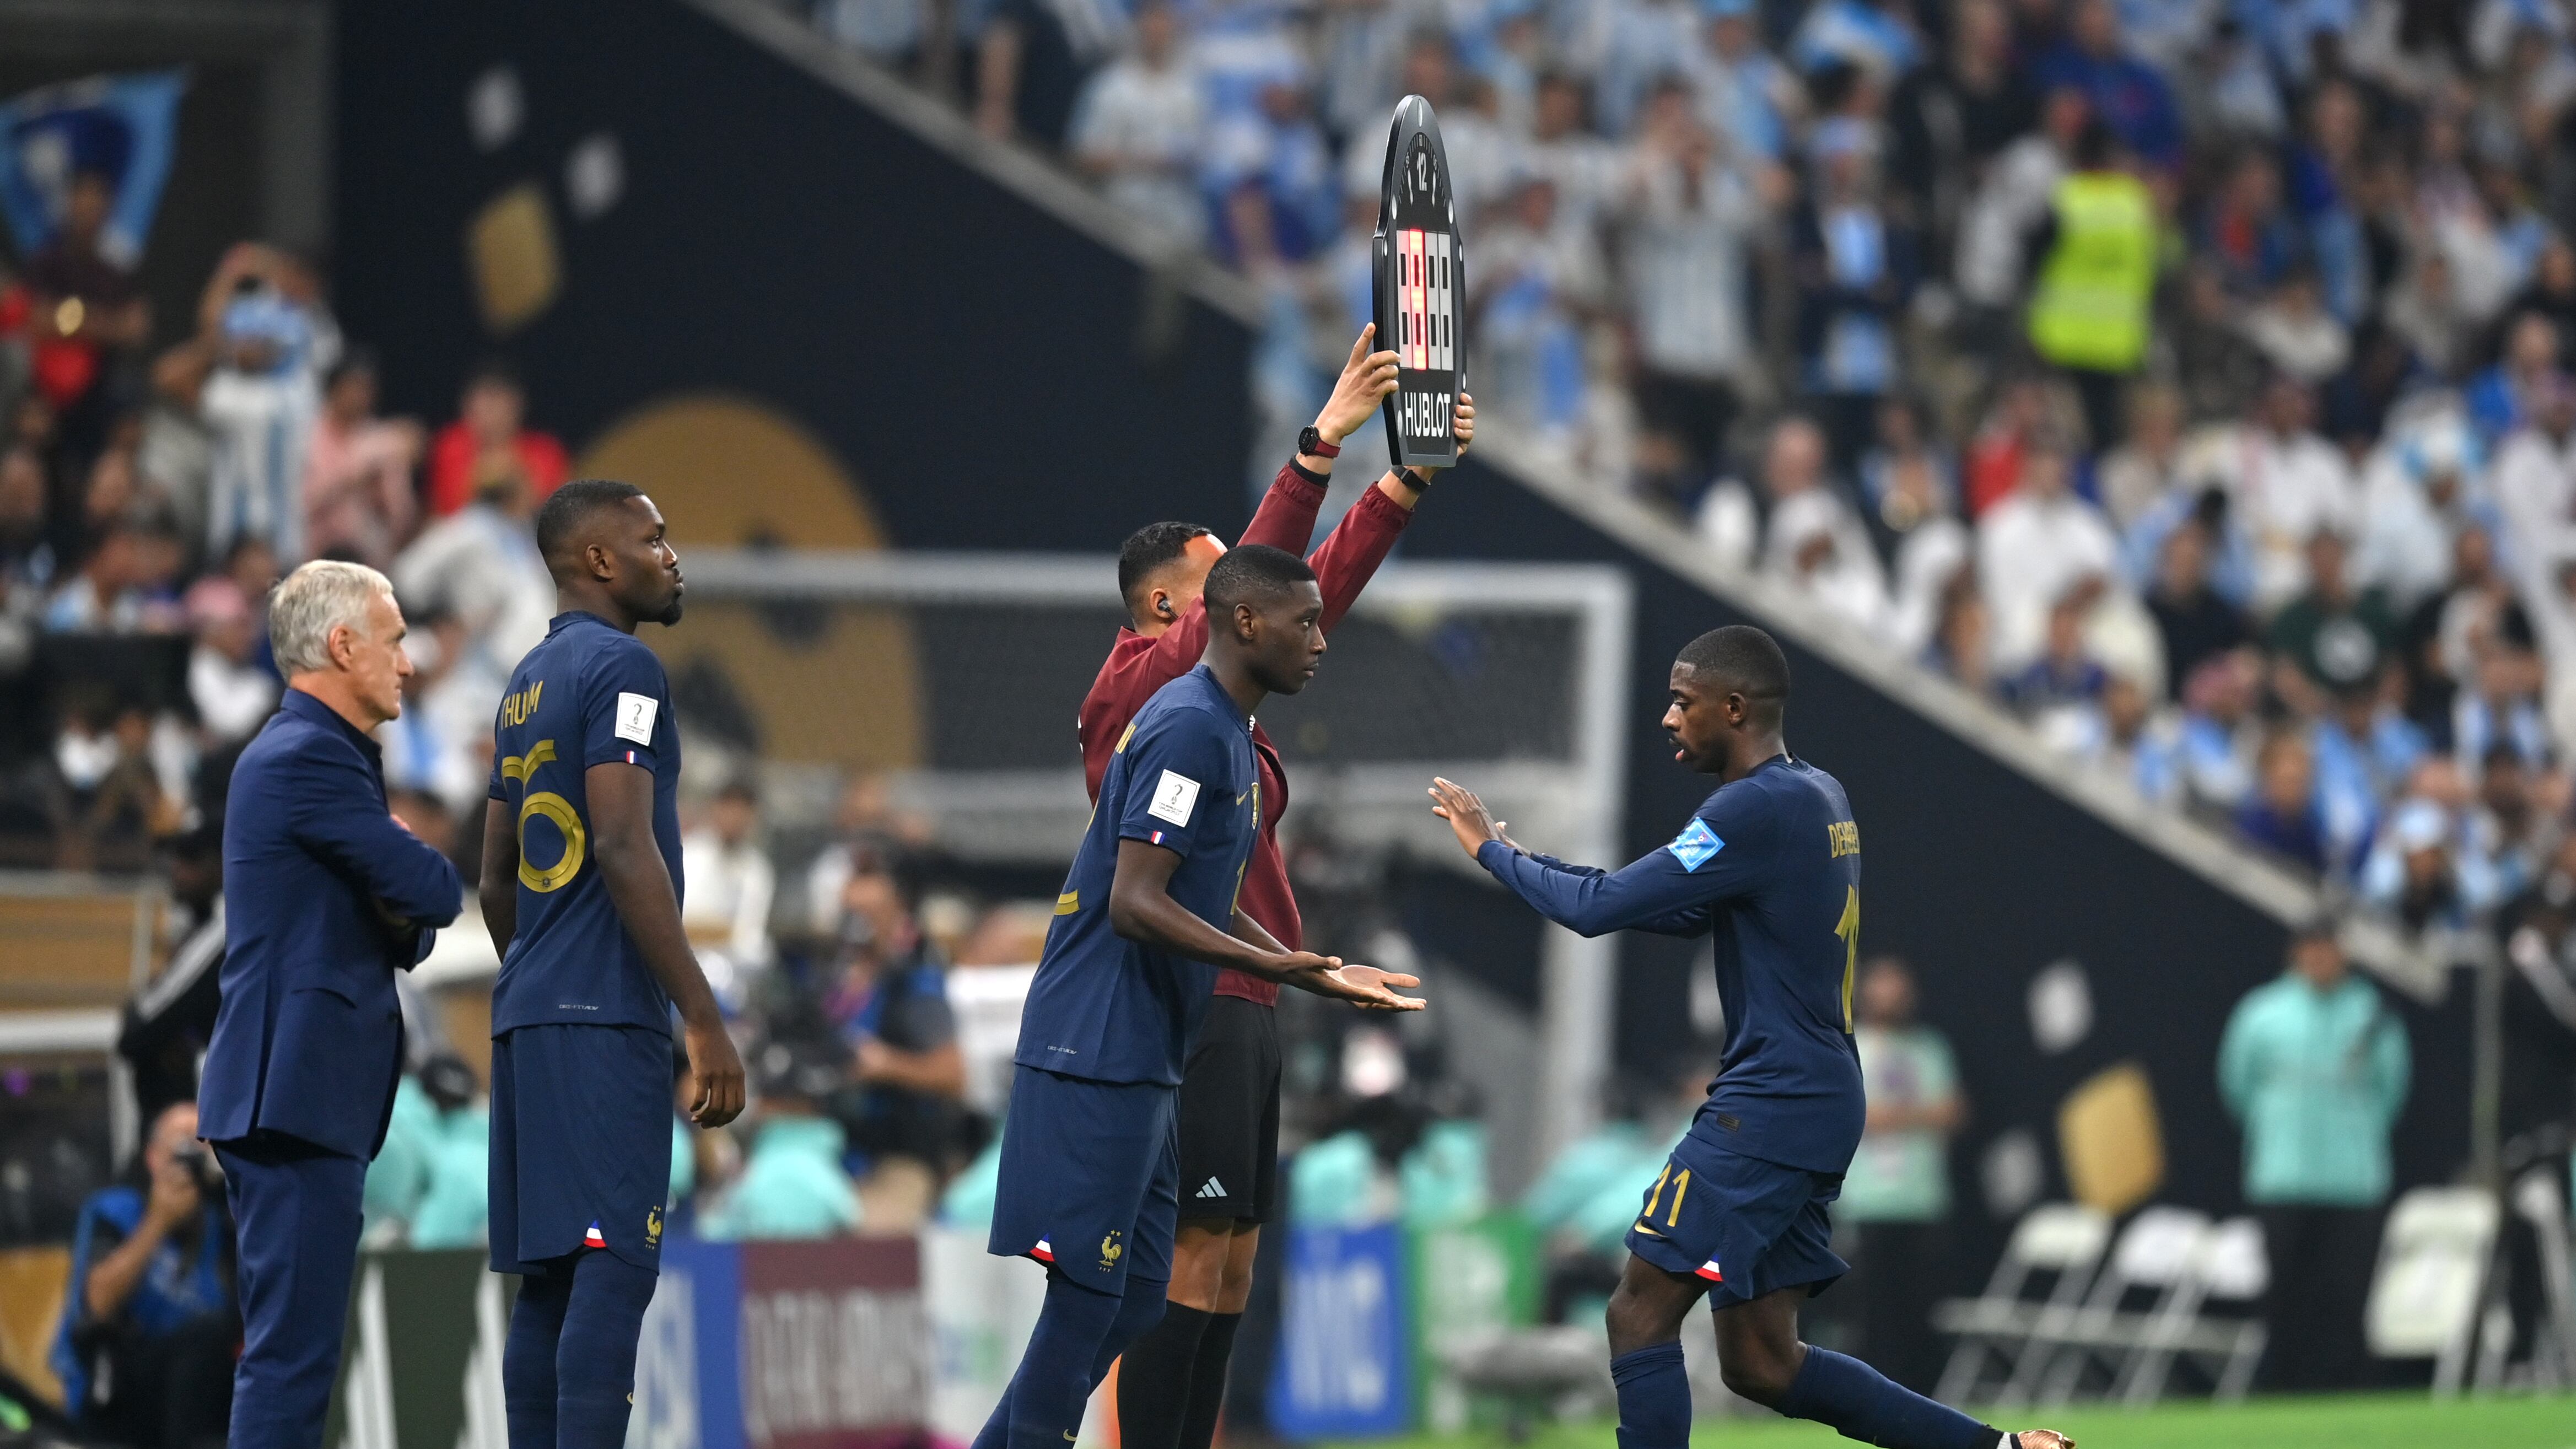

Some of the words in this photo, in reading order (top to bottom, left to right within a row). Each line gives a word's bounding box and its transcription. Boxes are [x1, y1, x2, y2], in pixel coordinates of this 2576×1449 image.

[1416, 152, 1427, 191] 12
[1405, 392, 1450, 438] HUBLOT
[1644, 1163, 1691, 1227] 11
